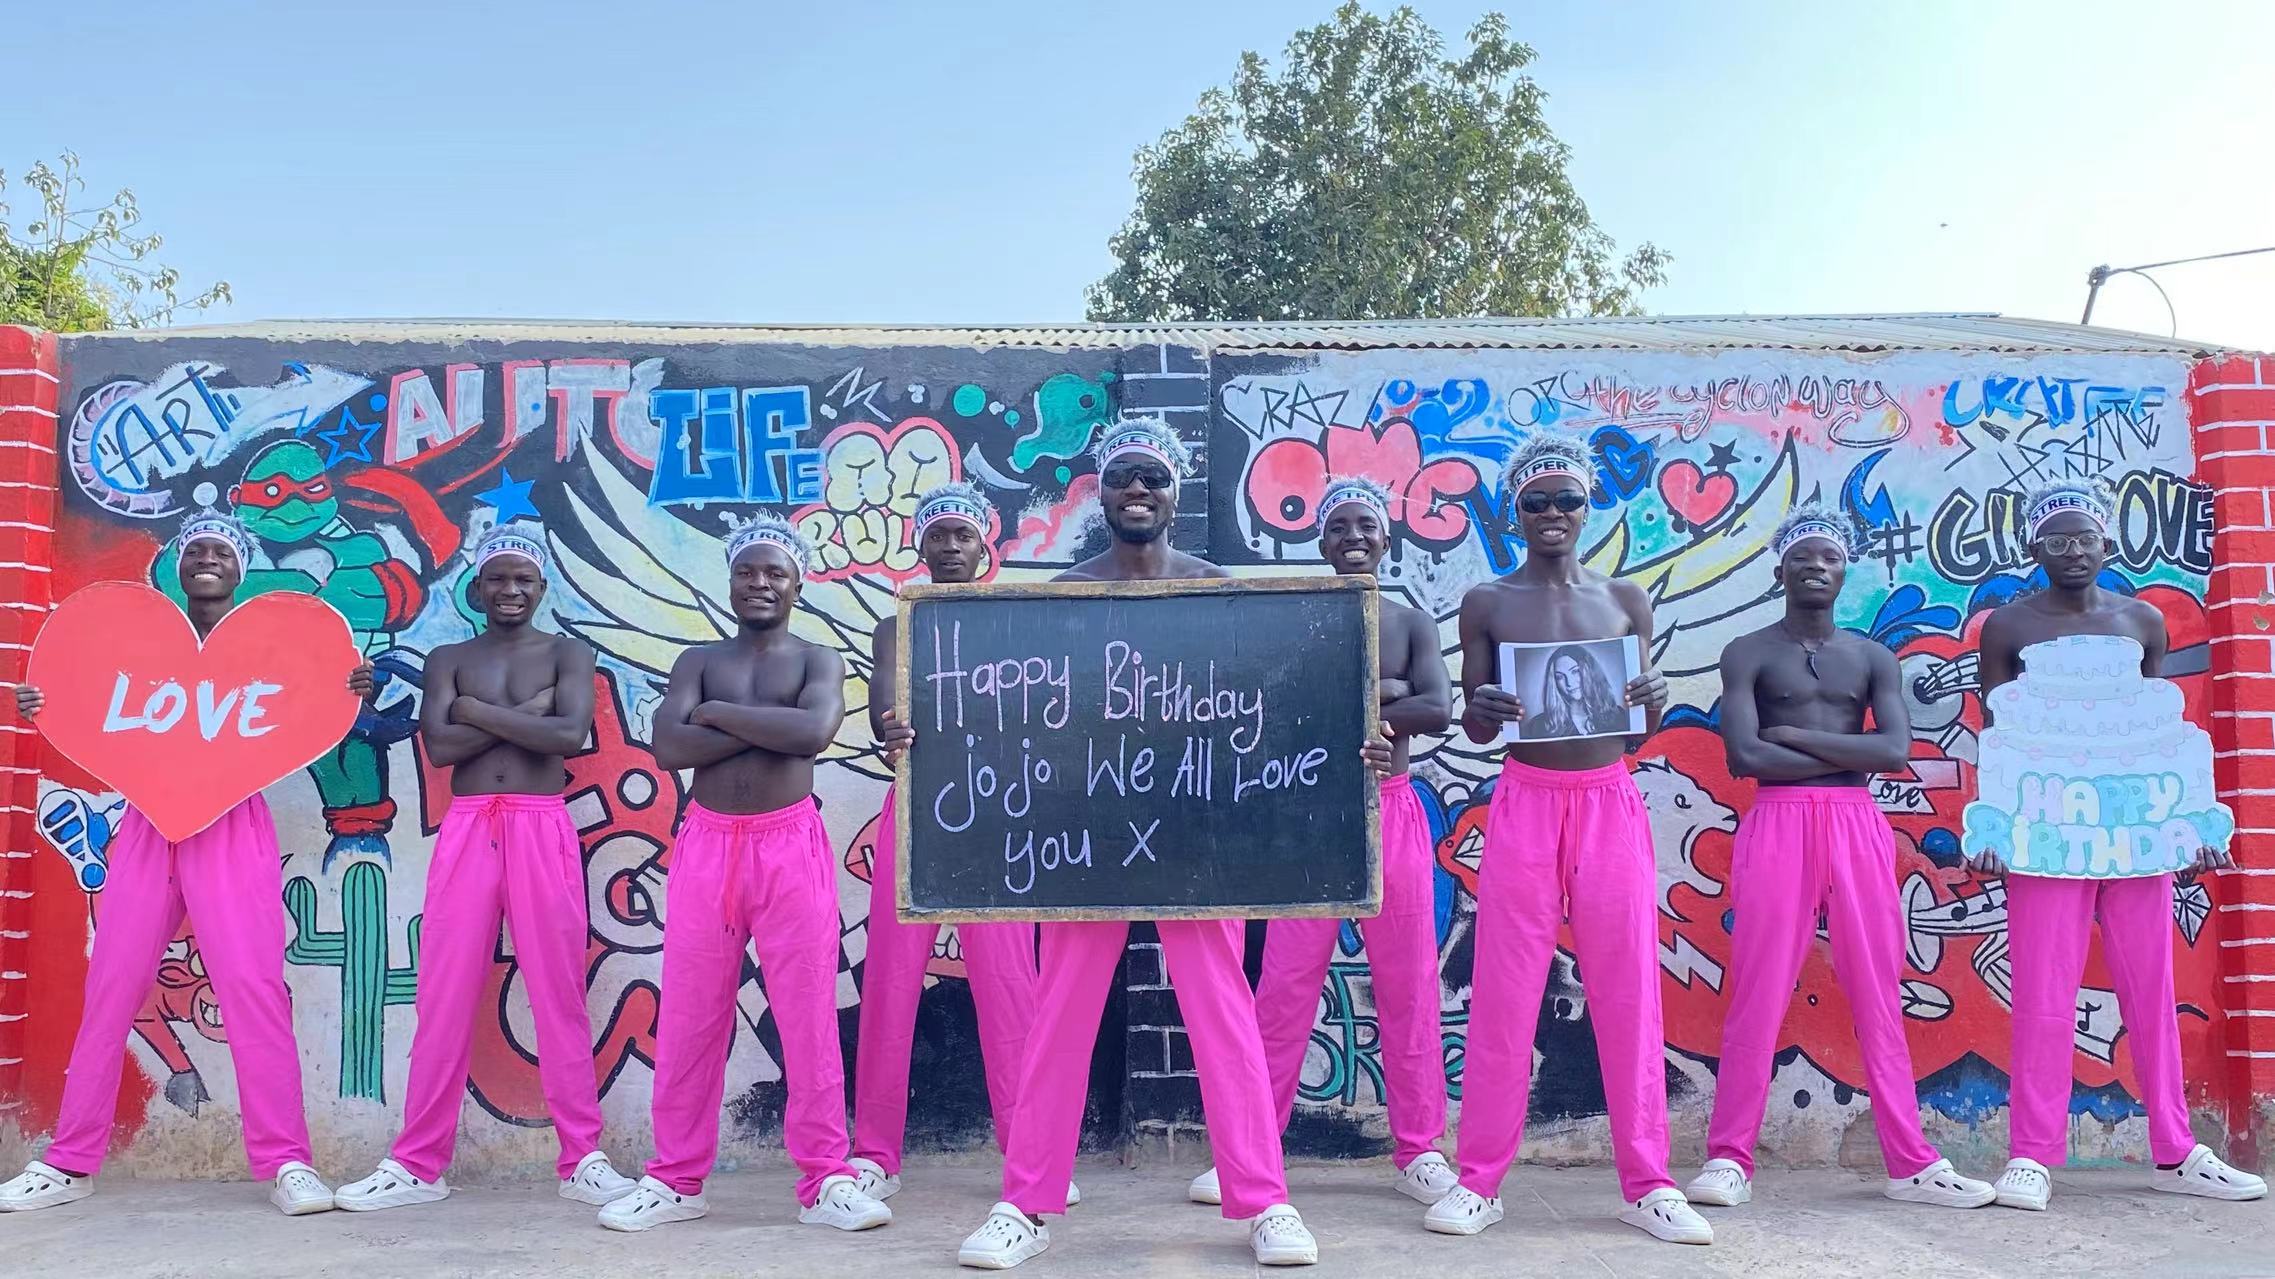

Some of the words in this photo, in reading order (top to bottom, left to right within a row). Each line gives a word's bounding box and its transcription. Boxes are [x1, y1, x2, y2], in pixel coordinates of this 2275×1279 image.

[1532, 460, 1569, 475] PER
[2030, 496, 2093, 526] STREET
[103, 671, 284, 742] LOVE
[925, 620, 1071, 732] Happy
[1103, 639, 1264, 754] Birthday
[1086, 733, 1155, 797] We
[1170, 735, 1213, 801] All
[1233, 747, 1329, 803] Love
[2017, 771, 2184, 827] HAPPY
[1004, 828, 1093, 895] you
